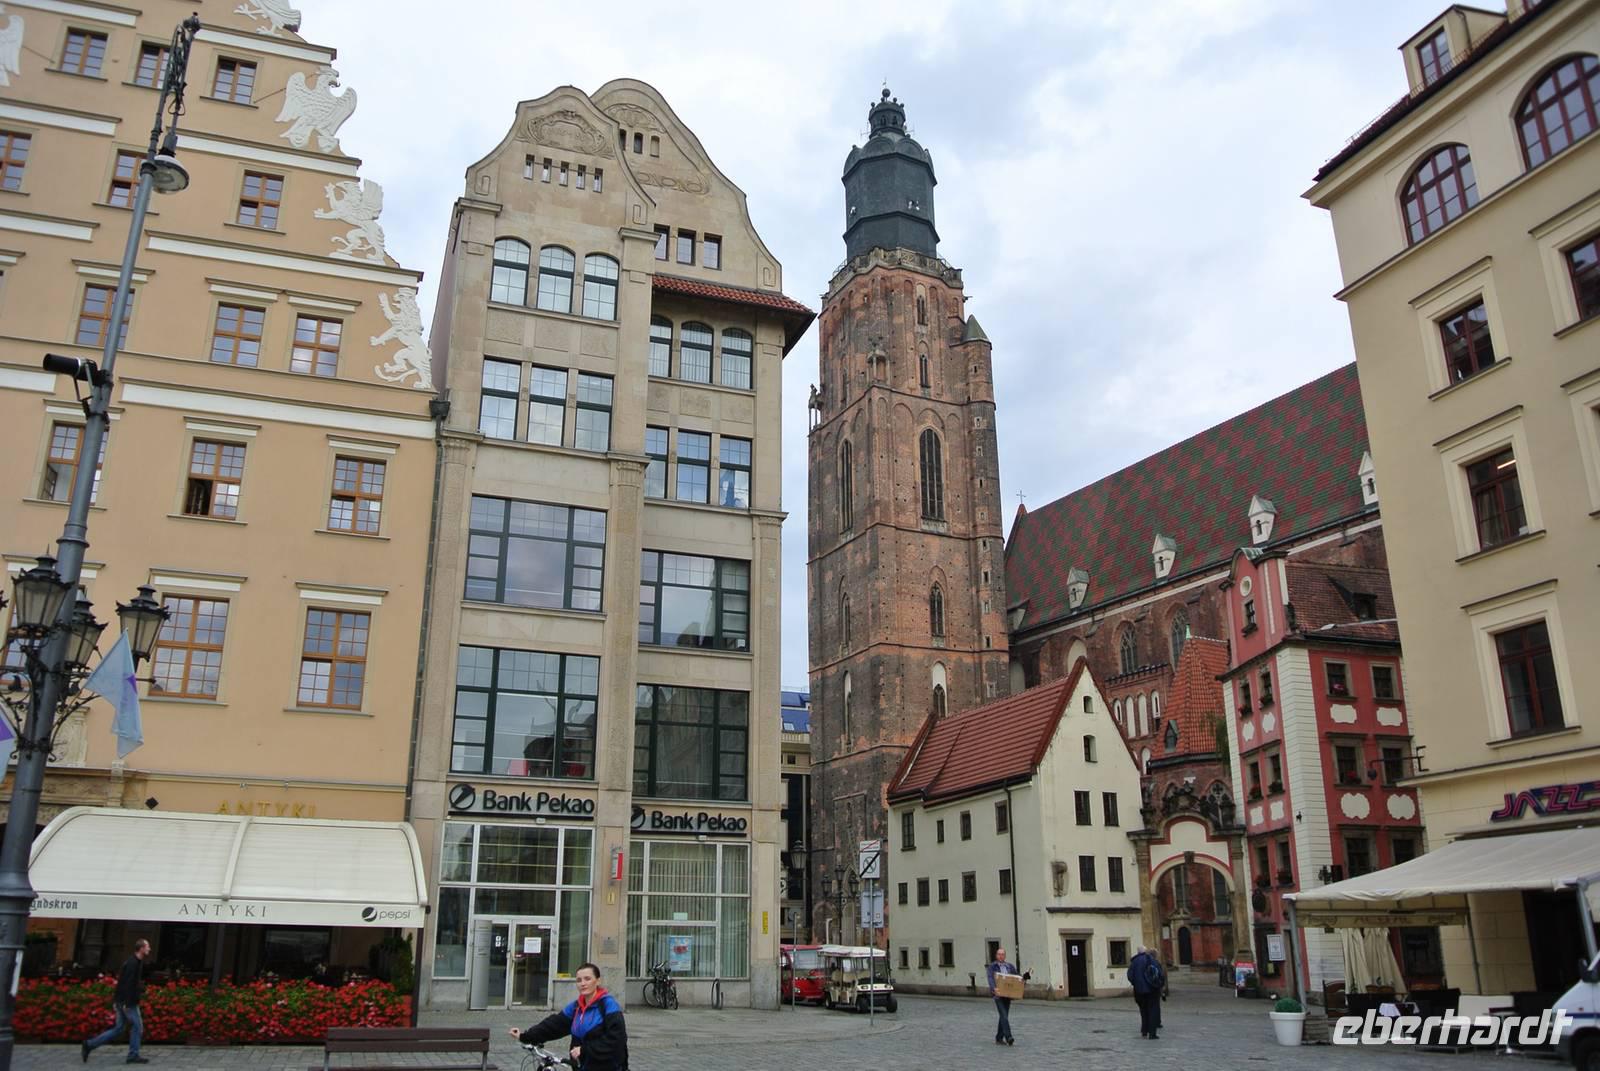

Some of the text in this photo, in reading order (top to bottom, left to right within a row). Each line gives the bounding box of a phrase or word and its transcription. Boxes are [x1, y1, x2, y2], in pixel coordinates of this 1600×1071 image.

[217, 800, 316, 817] ANTYKI
[482, 789, 595, 814] Bank Pekao
[651, 810, 747, 831] Bank Pekao
[178, 903, 267, 917] ANTYKI
[379, 910, 411, 920] pepsi
